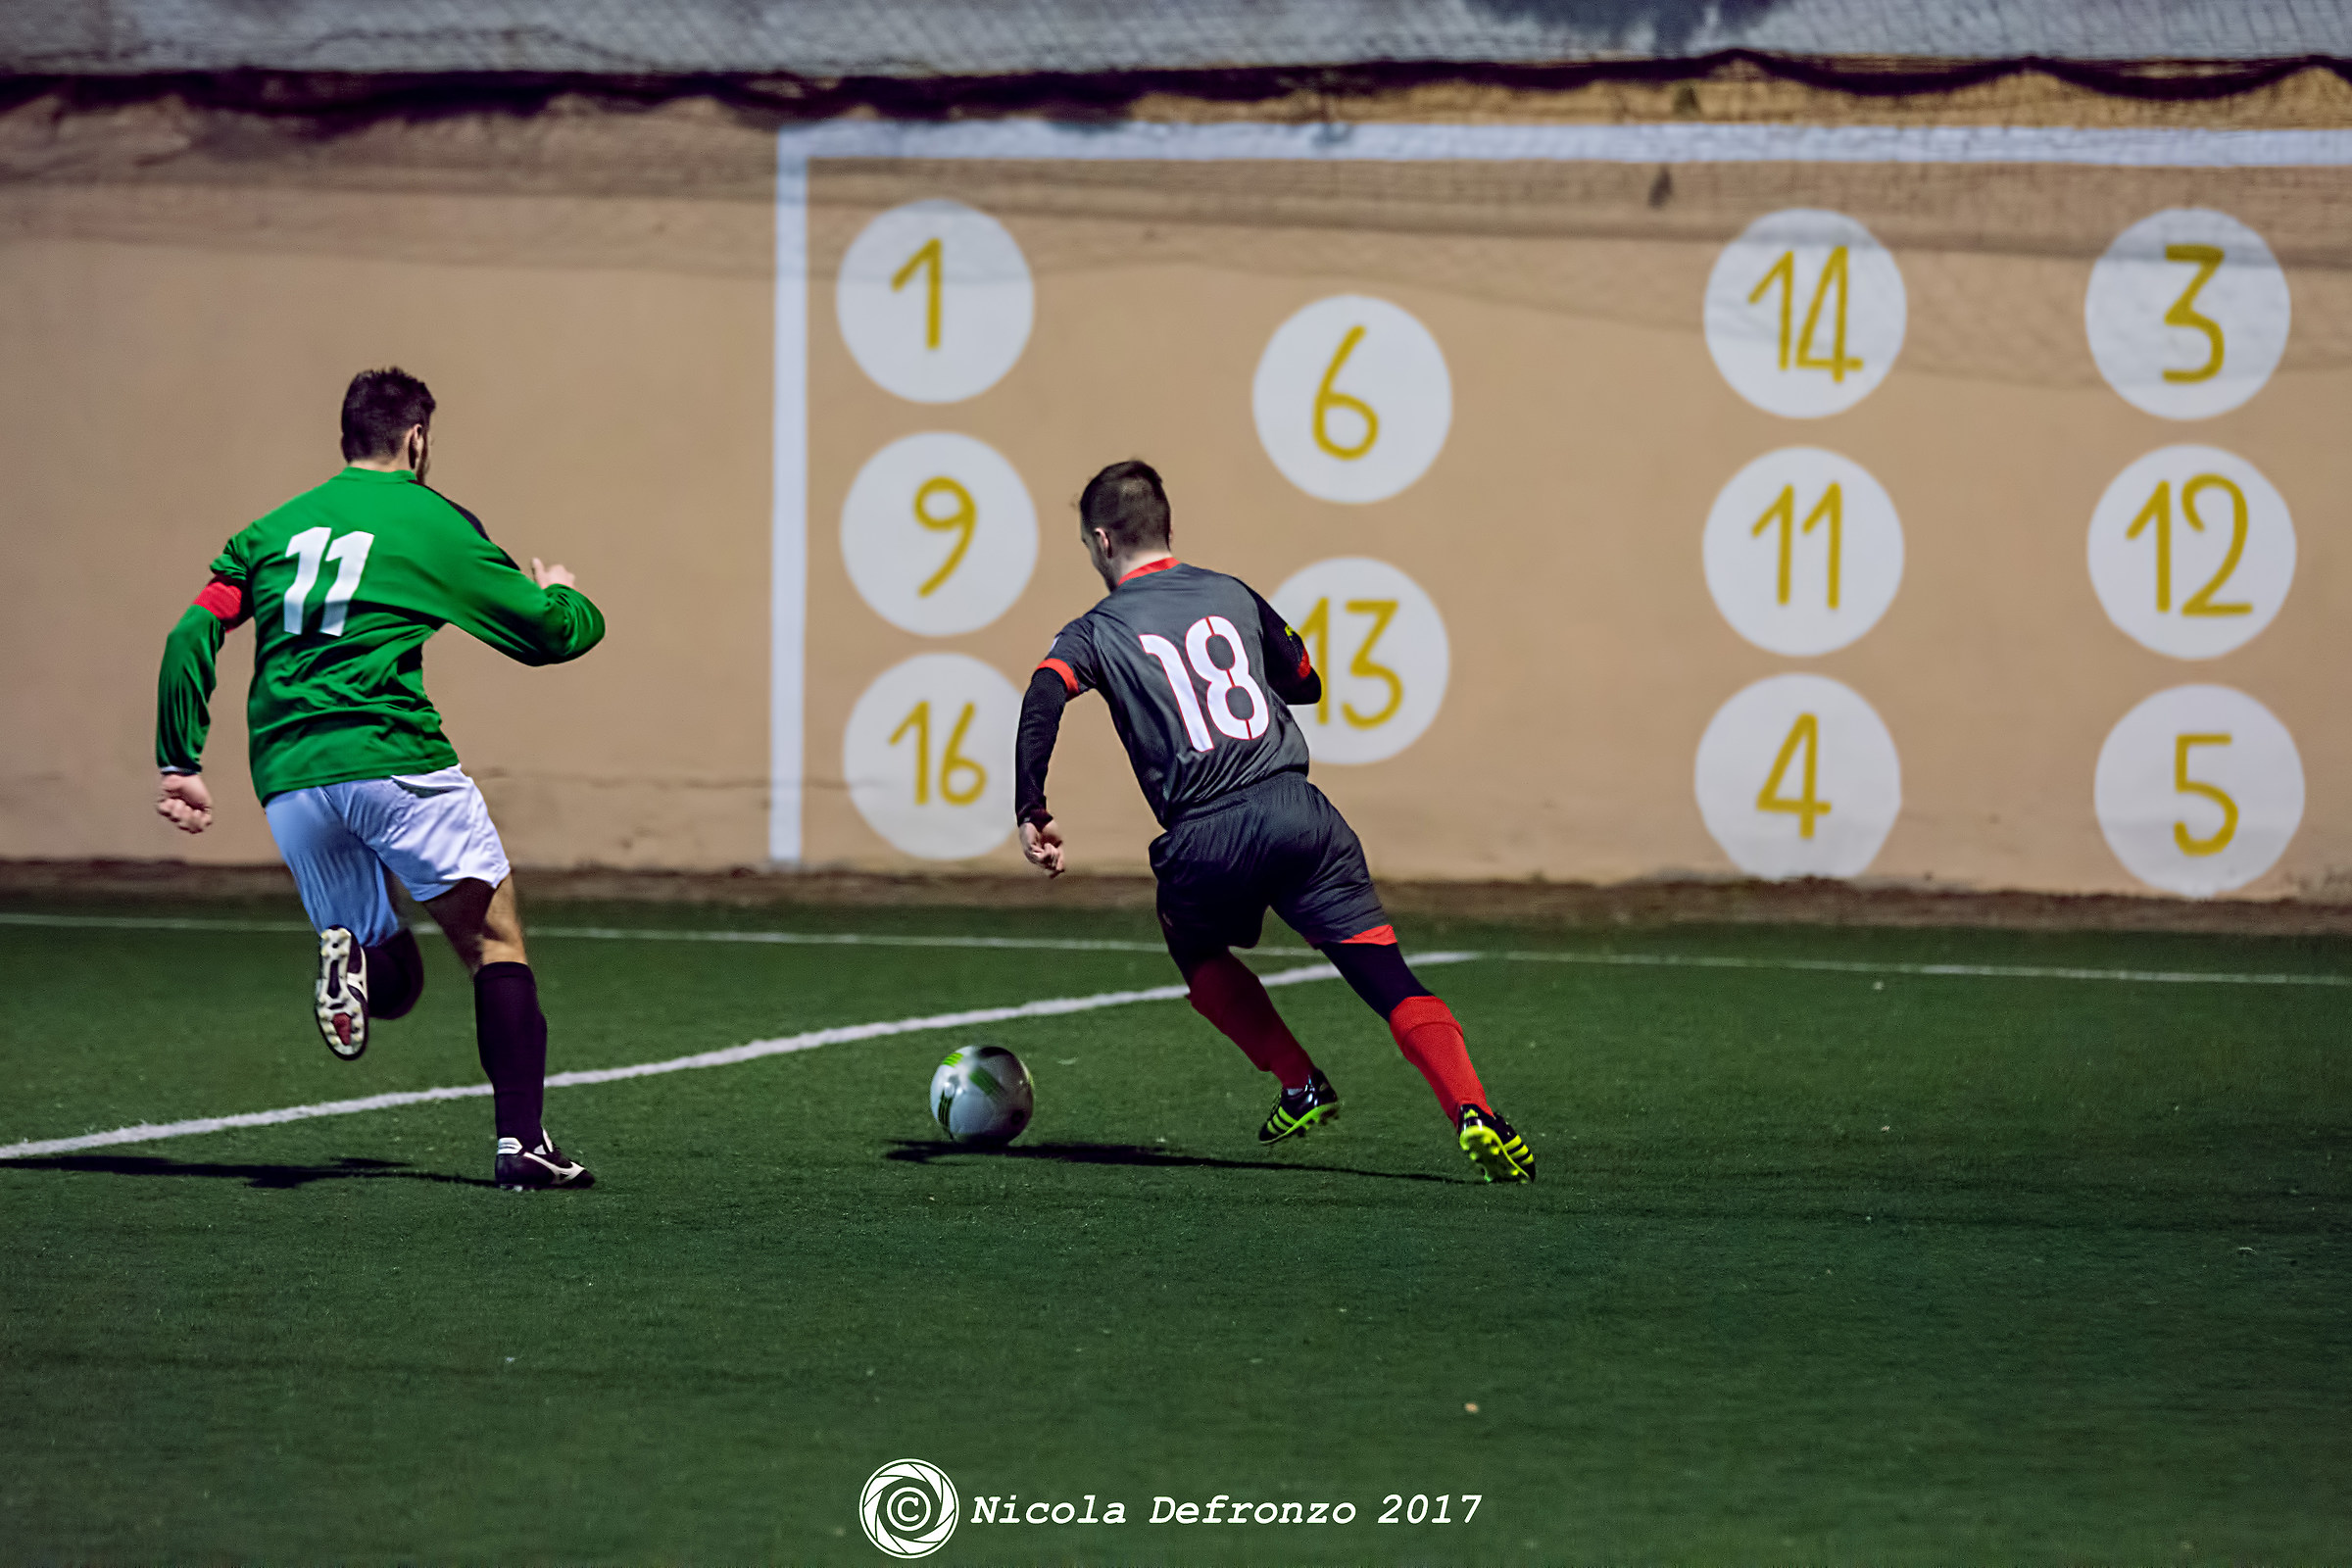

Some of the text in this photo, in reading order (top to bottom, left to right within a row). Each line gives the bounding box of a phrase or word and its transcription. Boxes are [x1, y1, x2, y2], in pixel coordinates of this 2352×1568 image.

[892, 238, 942, 349] 1
[1748, 246, 1864, 382] 14
[2163, 244, 2225, 383] 3
[1312, 325, 1379, 461] 6
[282, 525, 375, 638] 11
[914, 476, 977, 597] 9
[1751, 482, 1842, 610] 11
[2127, 473, 2253, 616] 12
[1139, 614, 1271, 753] 18
[1298, 597, 1404, 730] 13
[889, 701, 987, 806] 16
[1756, 713, 1832, 839] 4
[2173, 734, 2239, 857] 5
